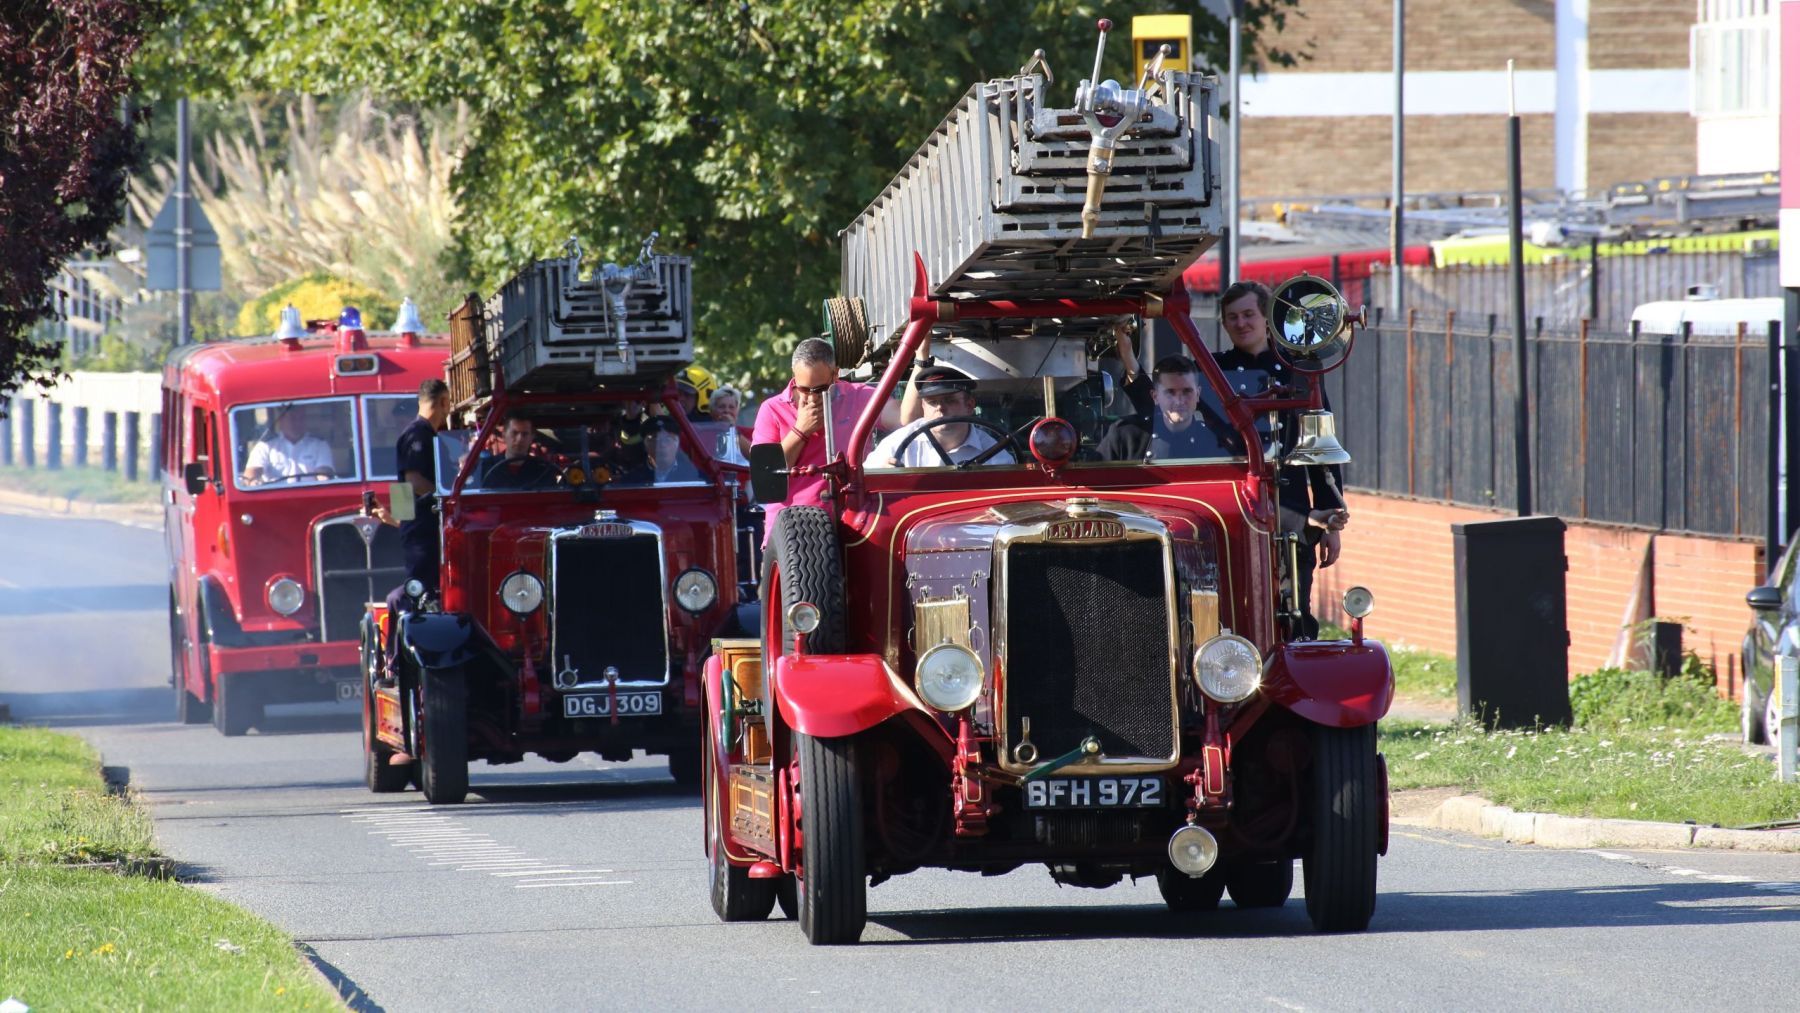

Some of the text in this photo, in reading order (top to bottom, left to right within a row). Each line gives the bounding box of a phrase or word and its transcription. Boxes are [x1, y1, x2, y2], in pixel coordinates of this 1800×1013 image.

[582, 523, 632, 537] LEYLAND
[1048, 520, 1122, 539] LEYLAND
[567, 694, 659, 715] DGJ 309
[1028, 778, 1160, 806] BFH 972
